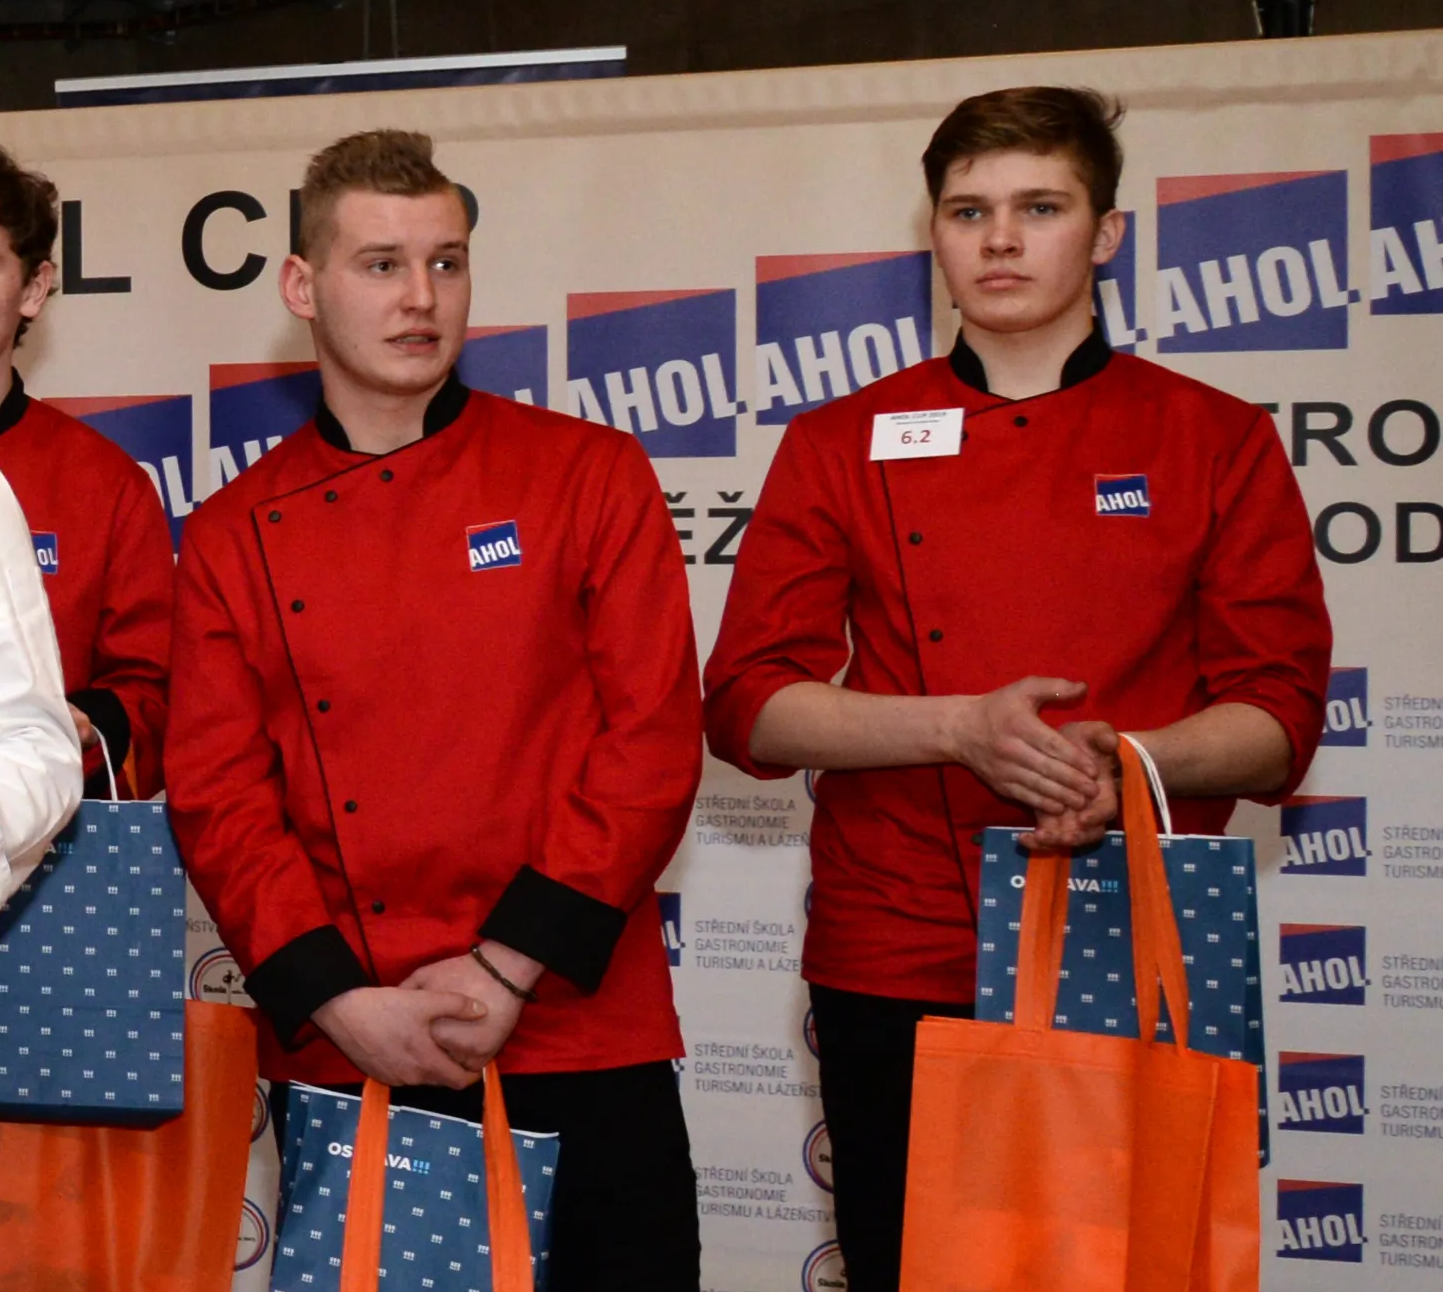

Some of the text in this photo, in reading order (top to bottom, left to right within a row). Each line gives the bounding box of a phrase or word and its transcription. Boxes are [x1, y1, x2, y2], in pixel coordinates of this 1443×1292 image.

[1157, 237, 1361, 341] AHOL
[566, 351, 748, 430] AHOL
[900, 428, 932, 445] 6.2
[1096, 488, 1150, 512] AHOL
[36, 548, 58, 566] OL
[469, 536, 522, 569] AHOL
[695, 794, 797, 812] STŘEDNÍ ŠKOLA
[695, 814, 789, 829] GASTRONOMIE
[696, 829, 809, 848] TURISMU A LÁZEŇ
[1279, 826, 1370, 867] AHOL
[694, 918, 795, 937] STŘEDNÍ ŠKOLA
[694, 938, 788, 954] GASTRONOMIE
[695, 955, 753, 972] TURISMU
[756, 957, 766, 972] A
[1278, 955, 1370, 996] AHOL
[694, 1042, 794, 1062] STŘEDNÍ ŠKOLA
[694, 1061, 788, 1079] GASTRONOMIE
[694, 1078, 822, 1099] TURISMU A LÁZEŇST
[1277, 1084, 1369, 1123] AHOL
[1380, 1213, 1442, 1230] STŘEDNÍ
[1276, 1212, 1368, 1252] AHOL
[1379, 1233, 1443, 1250] GASTRON
